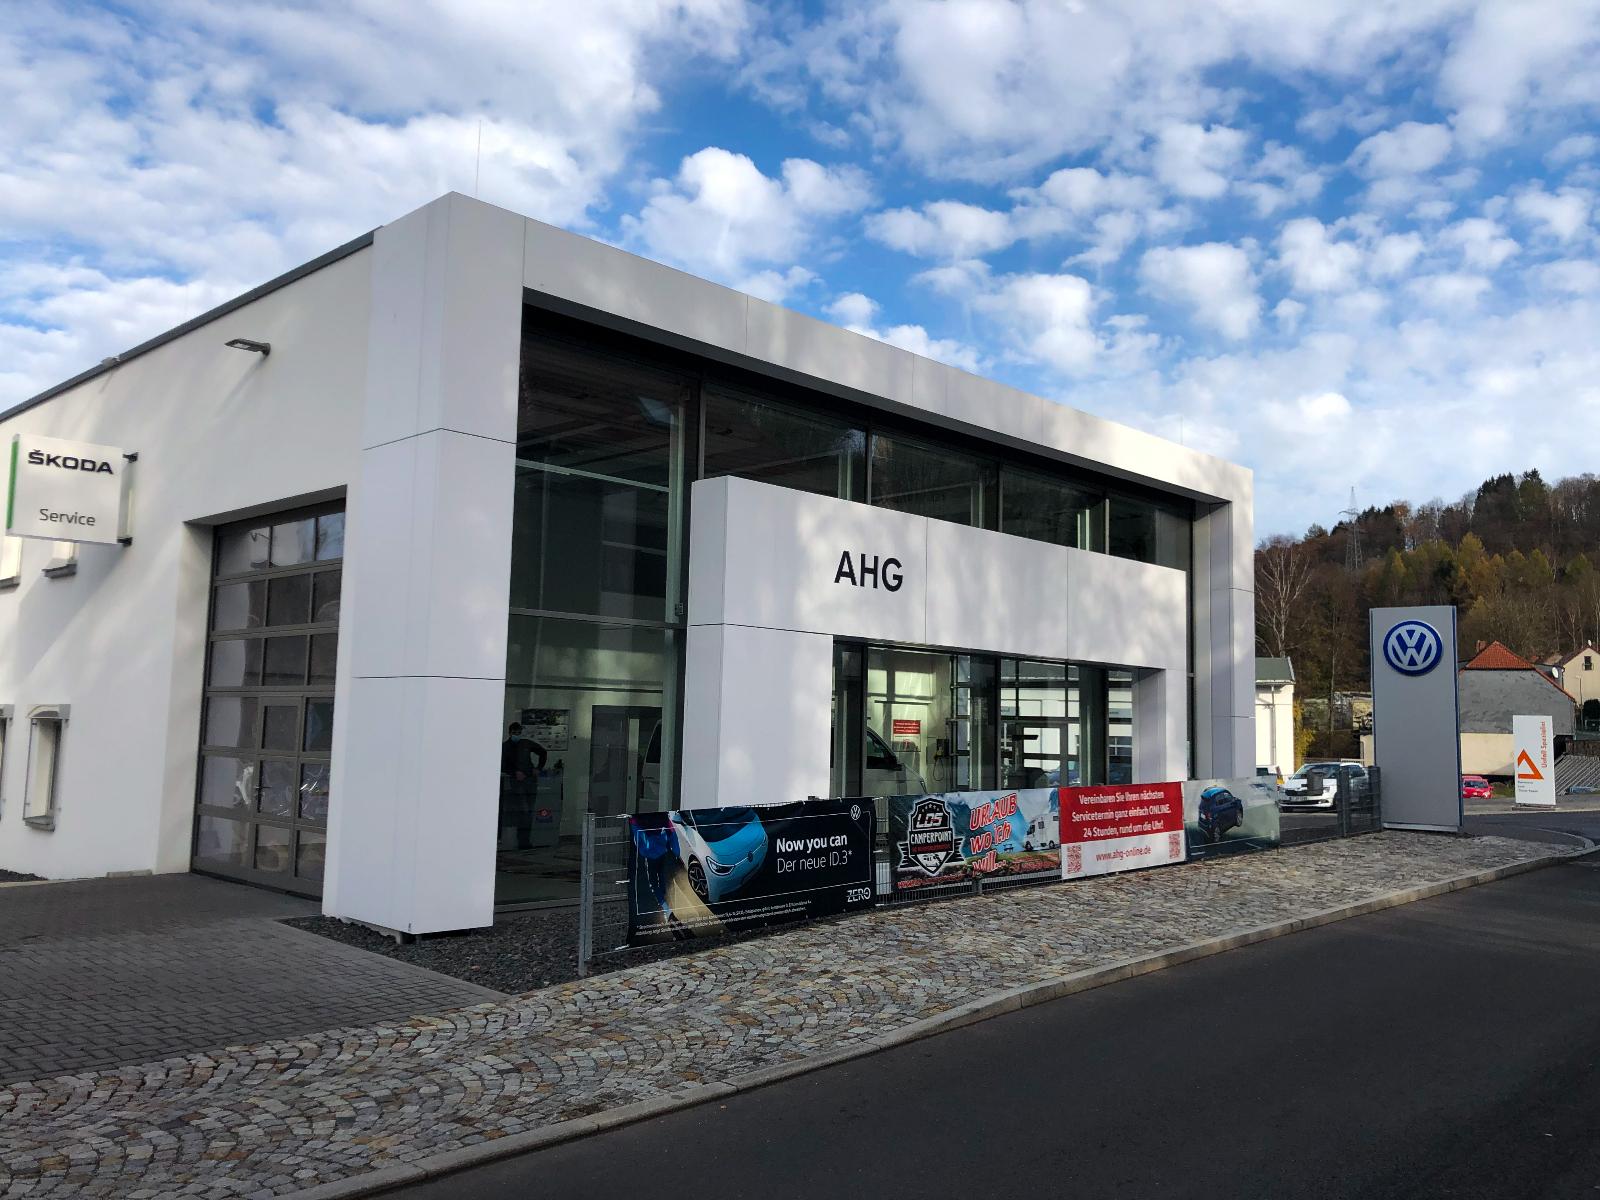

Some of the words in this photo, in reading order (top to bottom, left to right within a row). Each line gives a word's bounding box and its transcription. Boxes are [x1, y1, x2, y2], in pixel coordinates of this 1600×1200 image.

[28, 449, 114, 475] ŠKODA
[39, 508, 96, 526] Service
[834, 550, 903, 592] AHG
[1079, 794, 1115, 804] Vereinbaren
[1116, 792, 1124, 802] Sie
[1125, 791, 1139, 801] Ihren
[1140, 790, 1164, 800] nächsten
[969, 792, 1017, 831] URLAUB
[1072, 808, 1114, 822] Servicetermin
[1115, 809, 1128, 821] ganz
[1129, 806, 1148, 817] einfach
[910, 830, 952, 844] CAMPERPOINT
[1083, 828, 1092, 837] 24
[1093, 826, 1118, 837] Stunden,
[1120, 822, 1132, 833] rund
[1133, 824, 1142, 833] um
[1143, 821, 1151, 831] die
[1152, 820, 1164, 830] Uhr!
[776, 837, 804, 853] Now
[806, 837, 828, 853] you
[829, 834, 848, 847] can
[1095, 845, 1152, 862] www.ahg-online.de
[777, 857, 797, 873] Der
[799, 856, 826, 870] neue
[846, 887, 871, 903] ZERO
